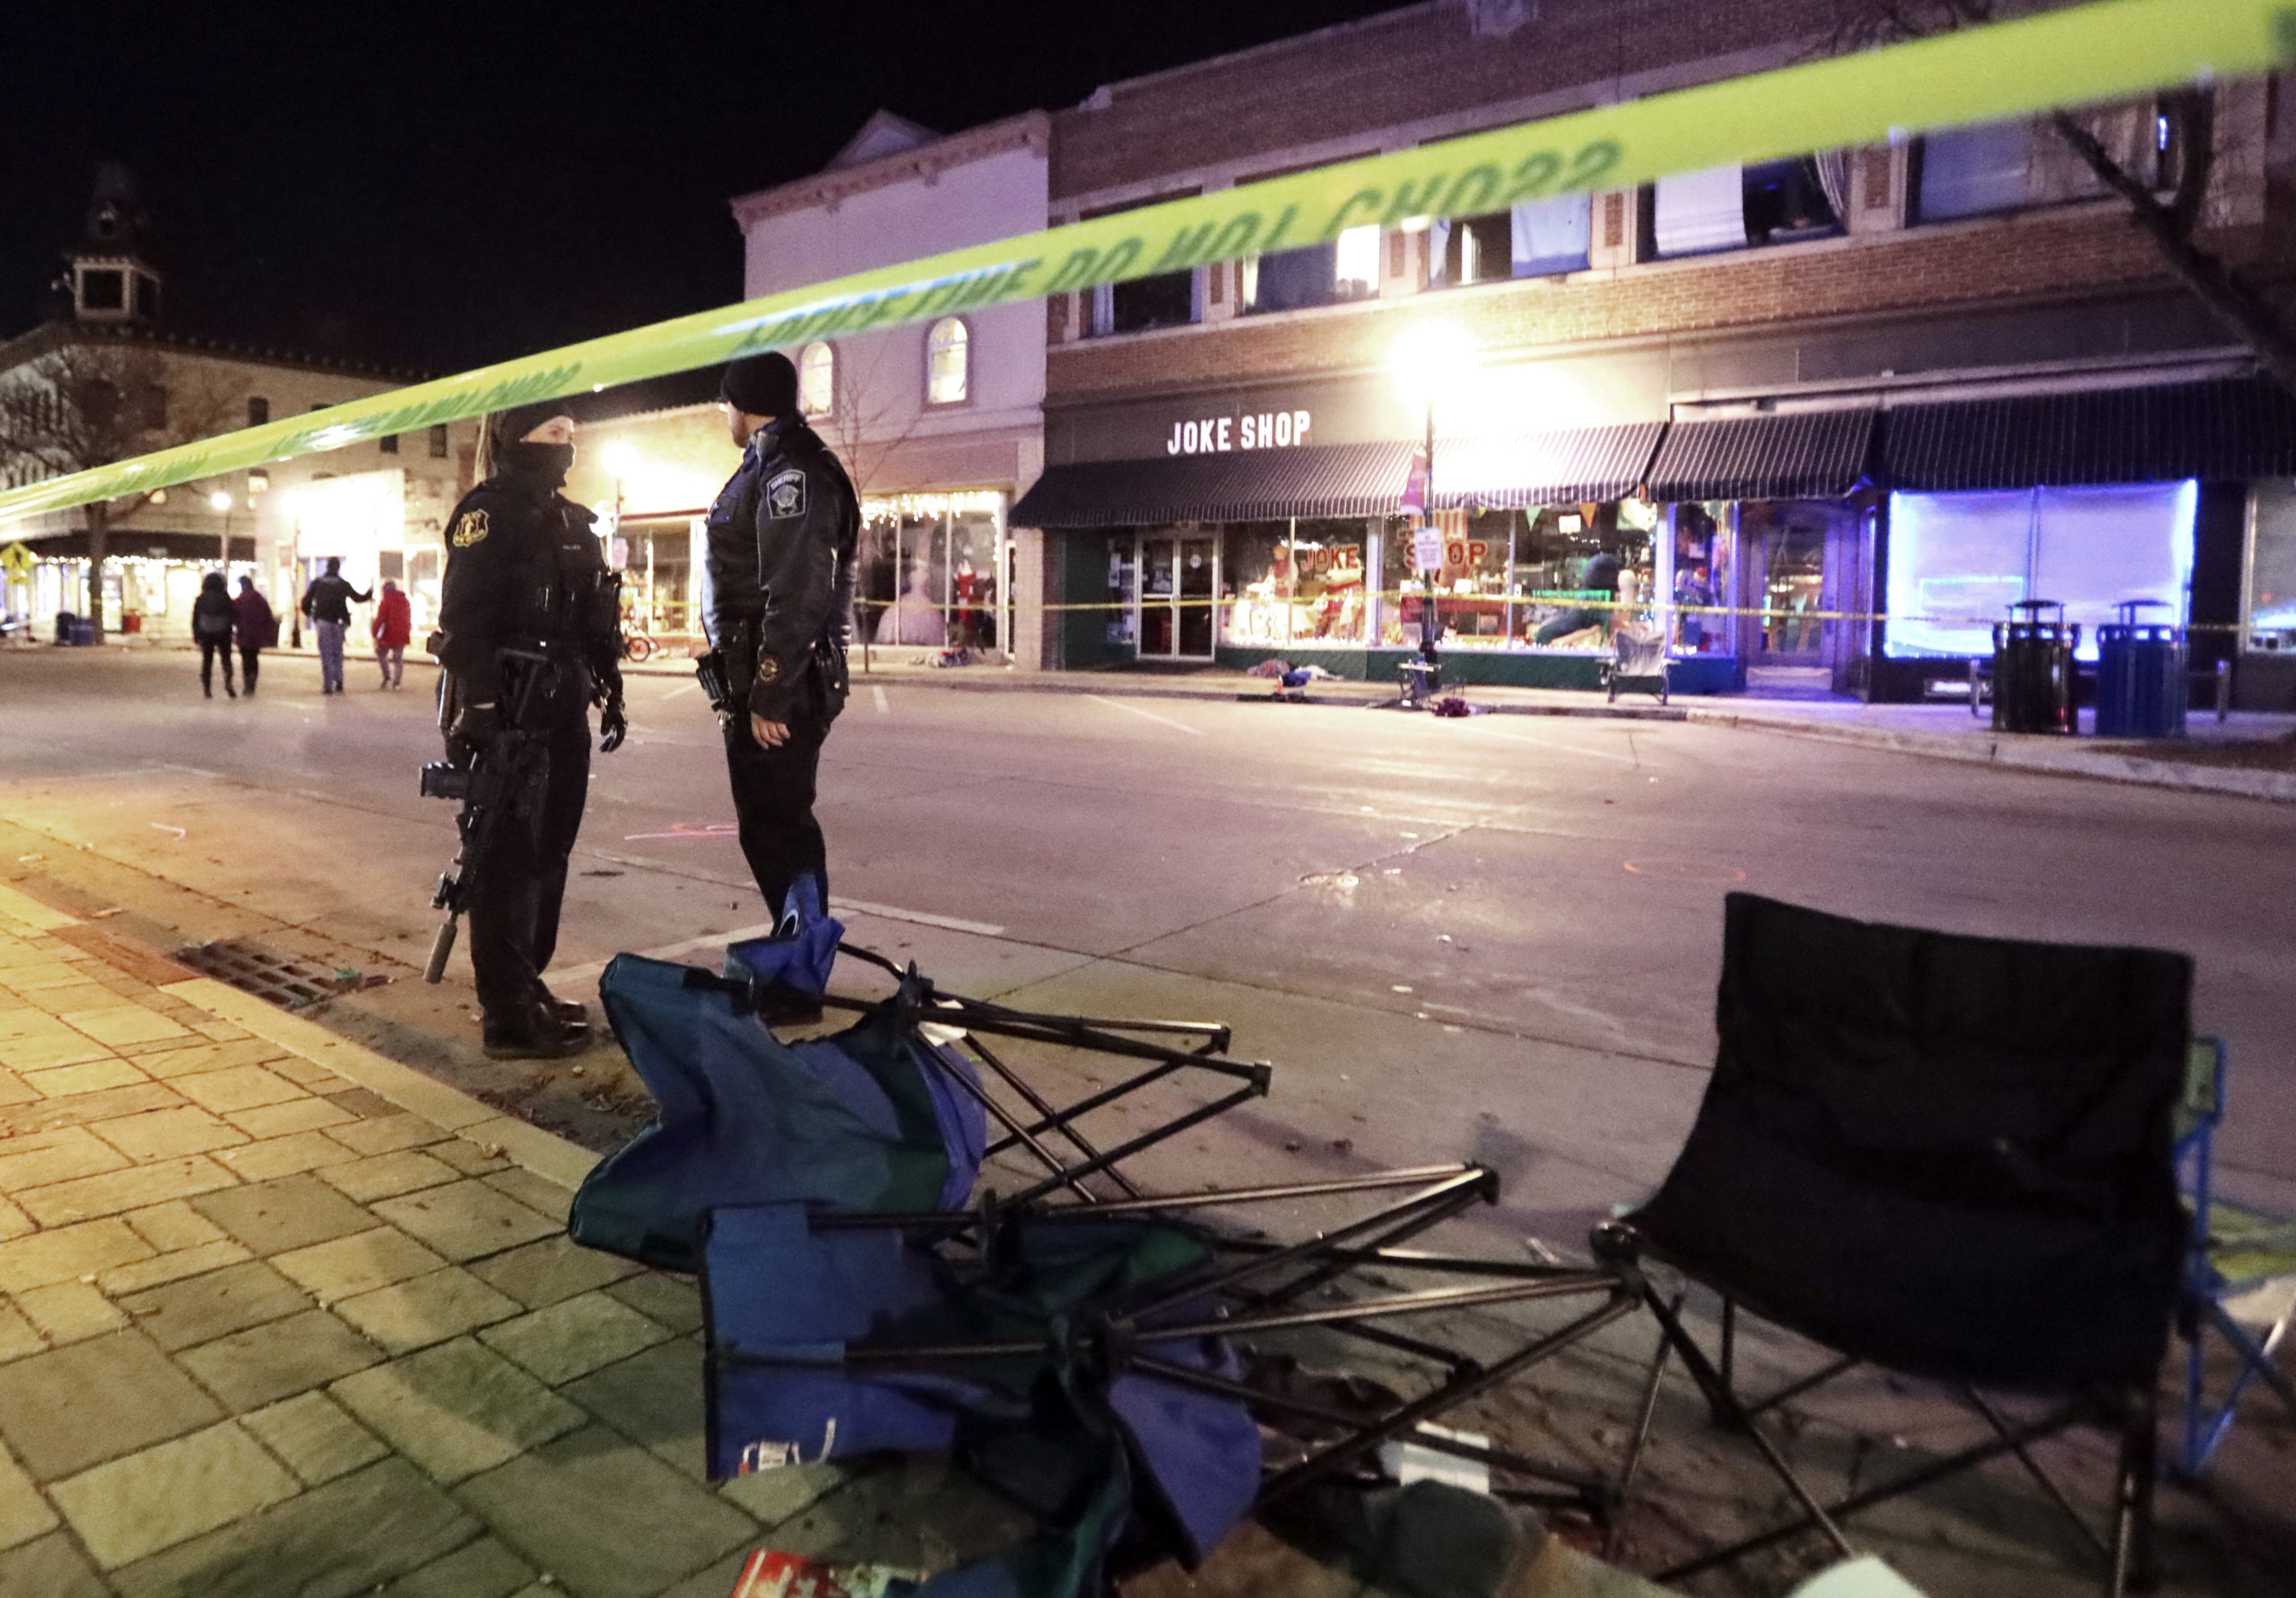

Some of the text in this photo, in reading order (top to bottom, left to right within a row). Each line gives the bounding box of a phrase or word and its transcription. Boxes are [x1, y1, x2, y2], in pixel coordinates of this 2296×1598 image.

[1167, 410, 1310, 455] JOKE SHOP
[1300, 543, 1360, 573] JOKE
[1405, 540, 1487, 568] SOP
